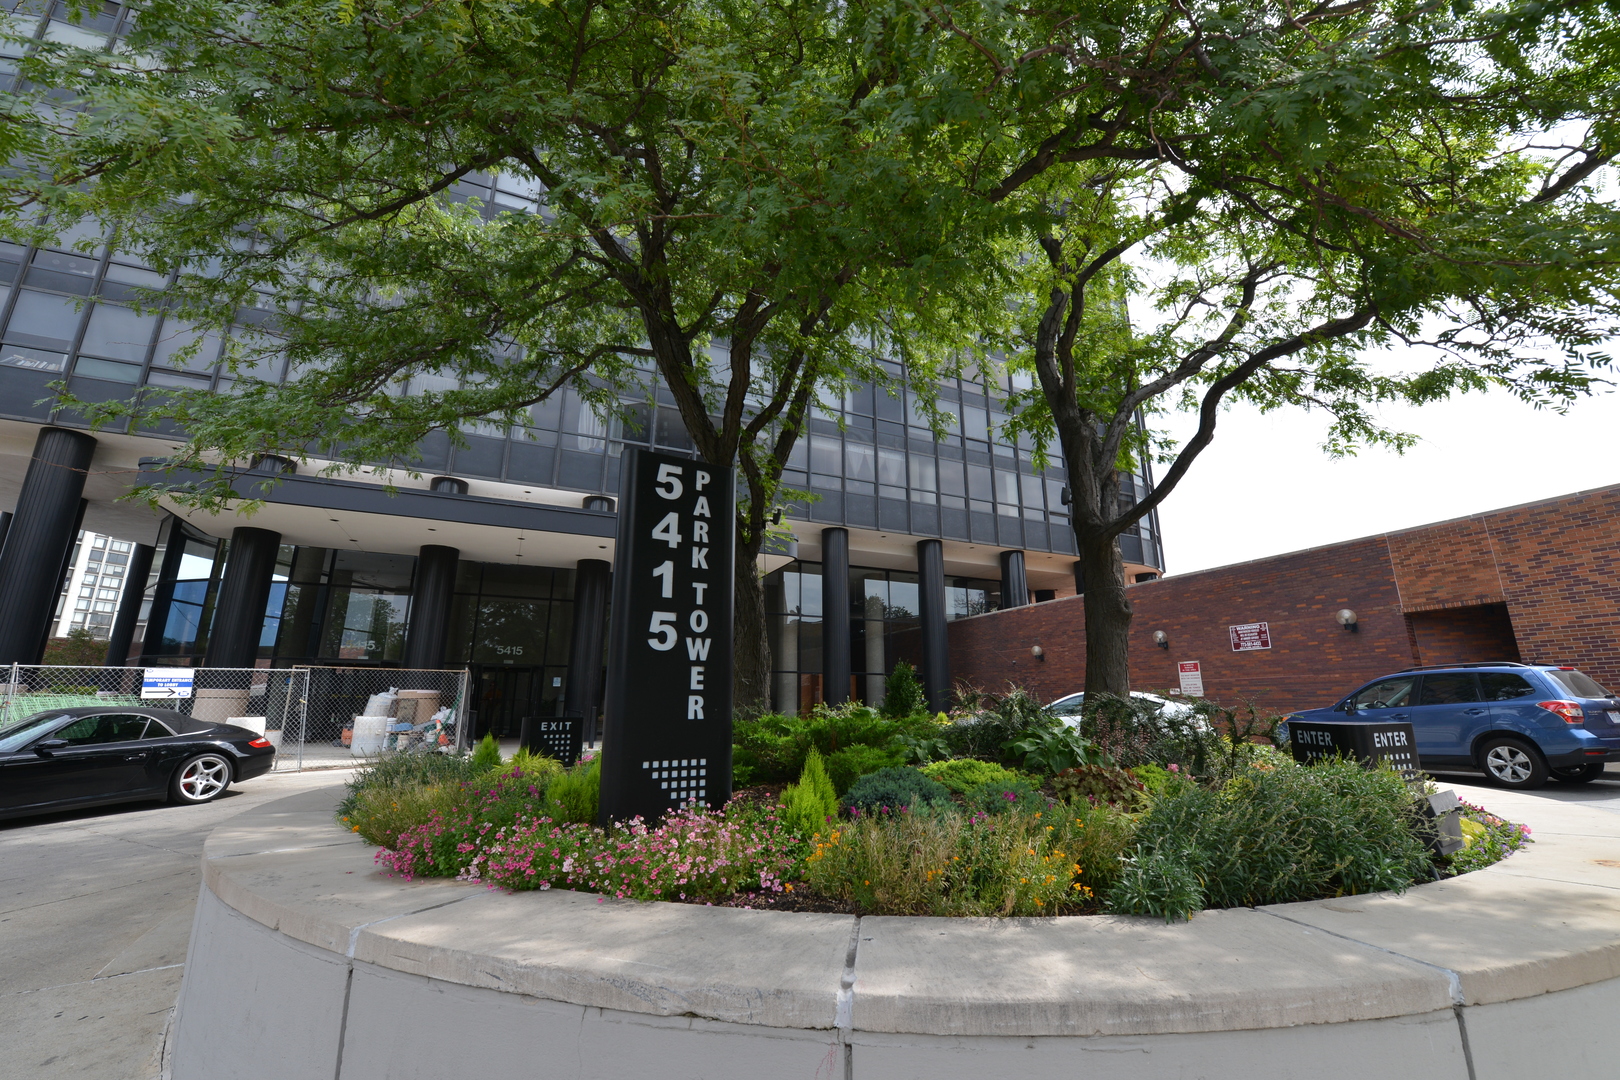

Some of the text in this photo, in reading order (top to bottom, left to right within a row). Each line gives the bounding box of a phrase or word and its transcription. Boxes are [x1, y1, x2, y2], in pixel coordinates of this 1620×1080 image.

[647, 462, 684, 652] 5415
[685, 470, 712, 720] PARK TOWER
[496, 645, 523, 655] 5415
[540, 721, 572, 731] EXIT
[1296, 730, 1333, 746] ENTER
[1373, 731, 1408, 748] ENTER
